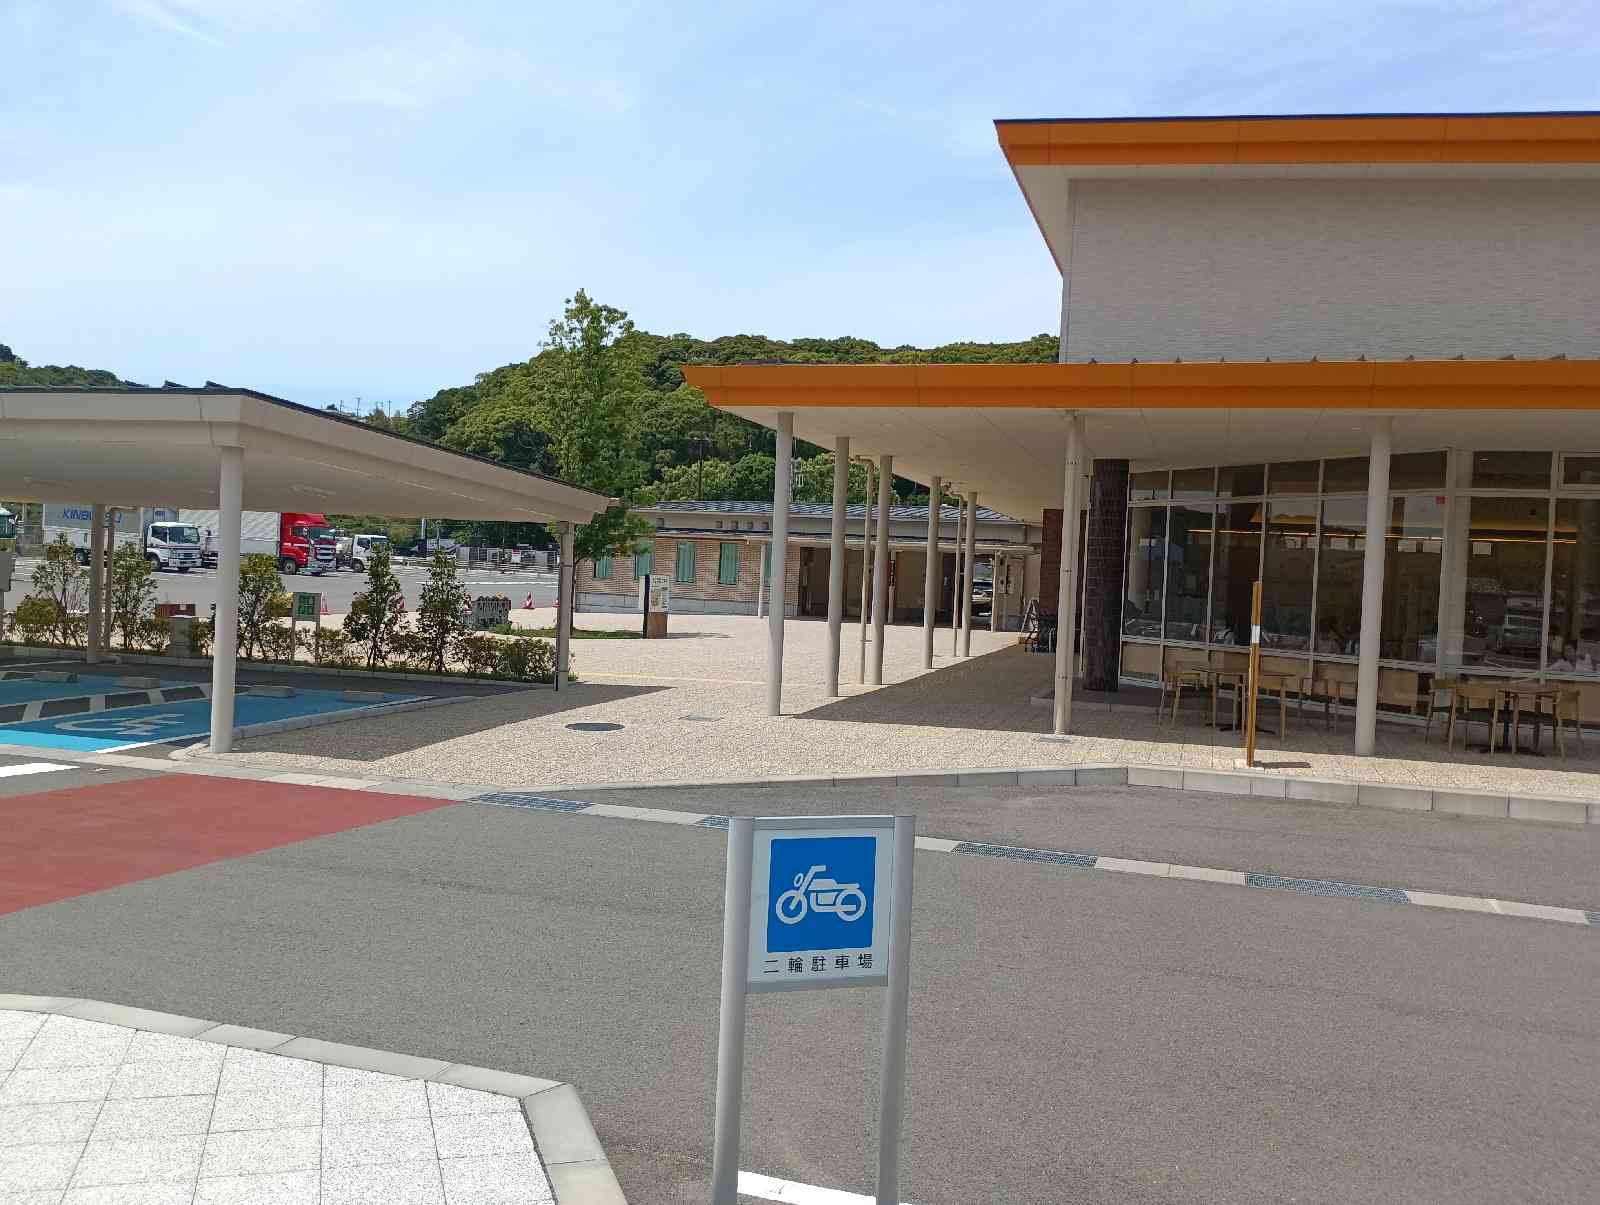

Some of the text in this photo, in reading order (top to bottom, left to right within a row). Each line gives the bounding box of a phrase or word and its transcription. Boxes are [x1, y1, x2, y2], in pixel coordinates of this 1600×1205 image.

[763, 953, 873, 973] 二輪駐車場
